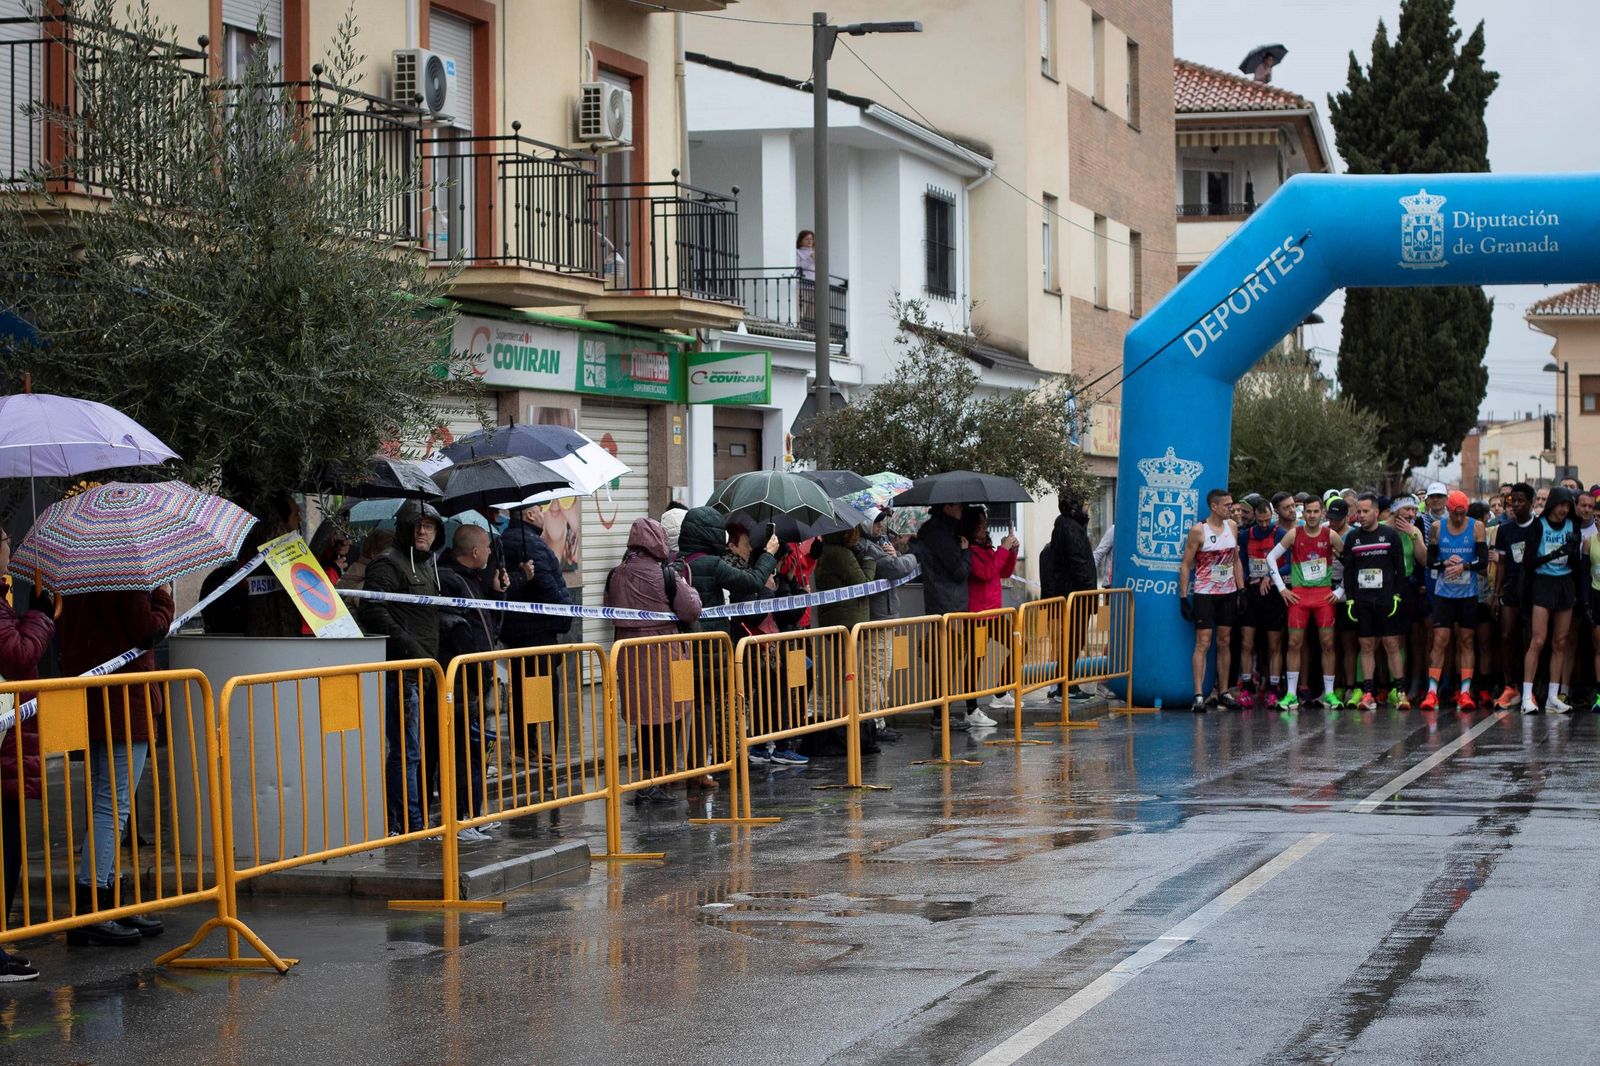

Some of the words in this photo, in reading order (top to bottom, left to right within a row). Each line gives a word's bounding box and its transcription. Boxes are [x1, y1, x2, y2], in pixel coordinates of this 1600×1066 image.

[1452, 209, 1560, 232] Diputación
[1452, 237, 1474, 255] de
[1480, 235, 1560, 254] Granada
[1182, 235, 1305, 358] DEPORTES
[493, 343, 561, 374] COVIRAN
[709, 374, 765, 384] COVIRAN
[1125, 577, 1195, 596] DEPORE
